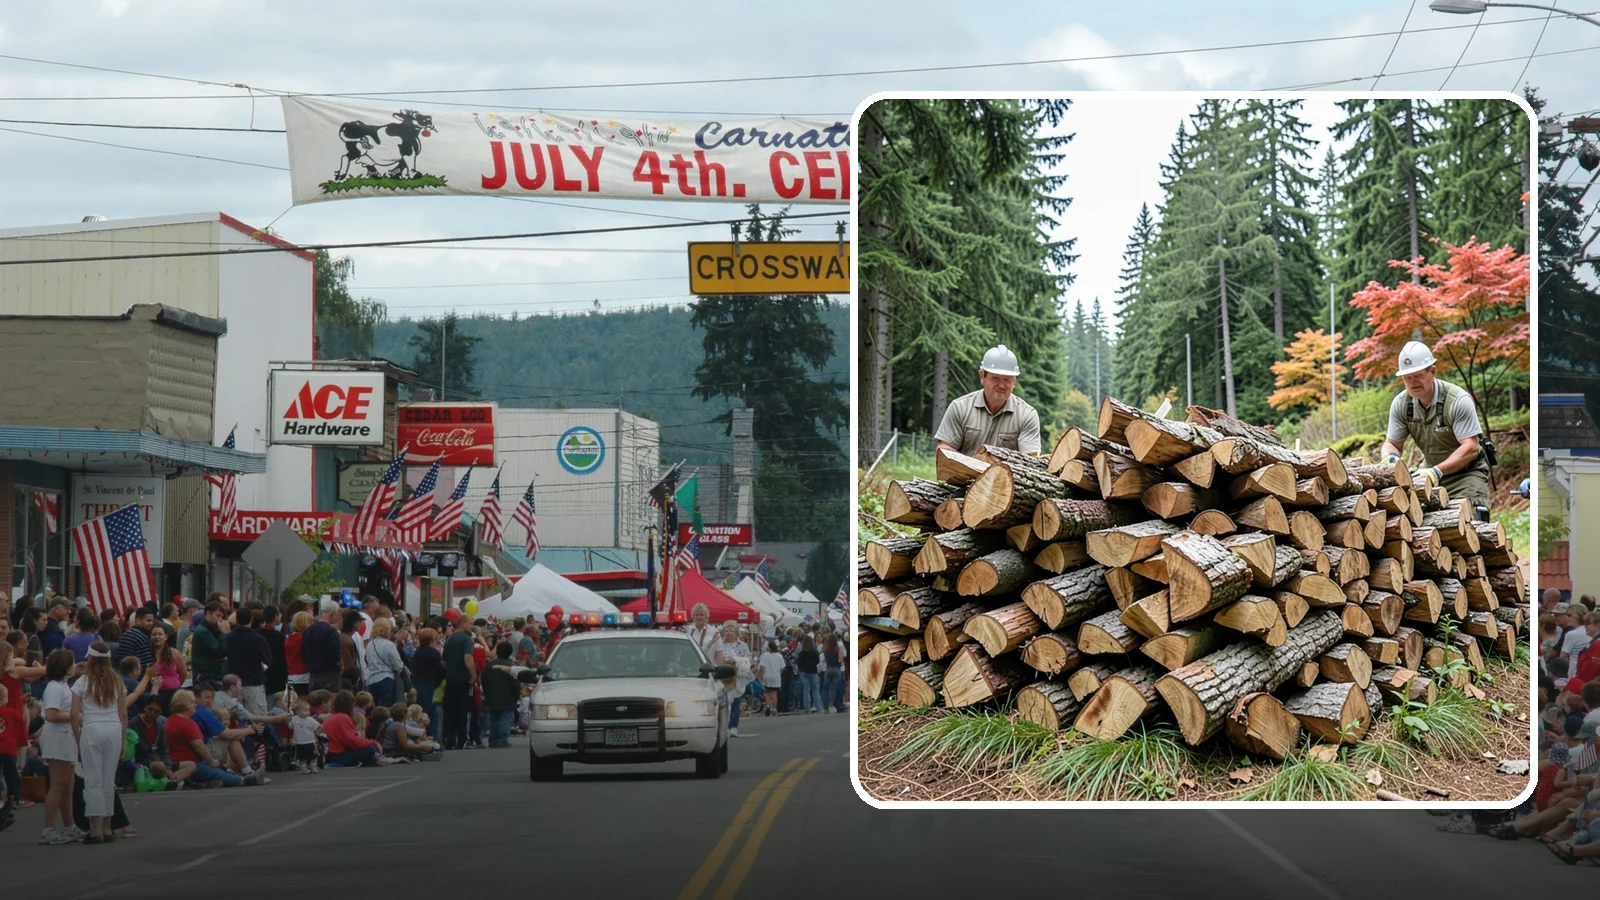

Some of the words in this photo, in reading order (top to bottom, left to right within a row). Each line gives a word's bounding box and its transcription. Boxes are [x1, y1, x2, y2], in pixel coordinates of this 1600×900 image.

[481, 141, 605, 192] JULY
[632, 150, 746, 198] 4th.
[697, 255, 850, 280] CROSSWA
[282, 380, 374, 420] ACE
[405, 409, 453, 422] CEDAR
[283, 421, 371, 436] Hardware
[416, 428, 477, 447] Coca-Cola
[353, 467, 386, 480] Simpl
[83, 485, 93, 494] St.
[96, 485, 124, 495] Vincent
[126, 485, 136, 495] de
[137, 485, 155, 495] Paul
[81, 503, 154, 522] THT
[688, 526, 742, 535] CRNATION
[699, 535, 730, 543] GLASS
